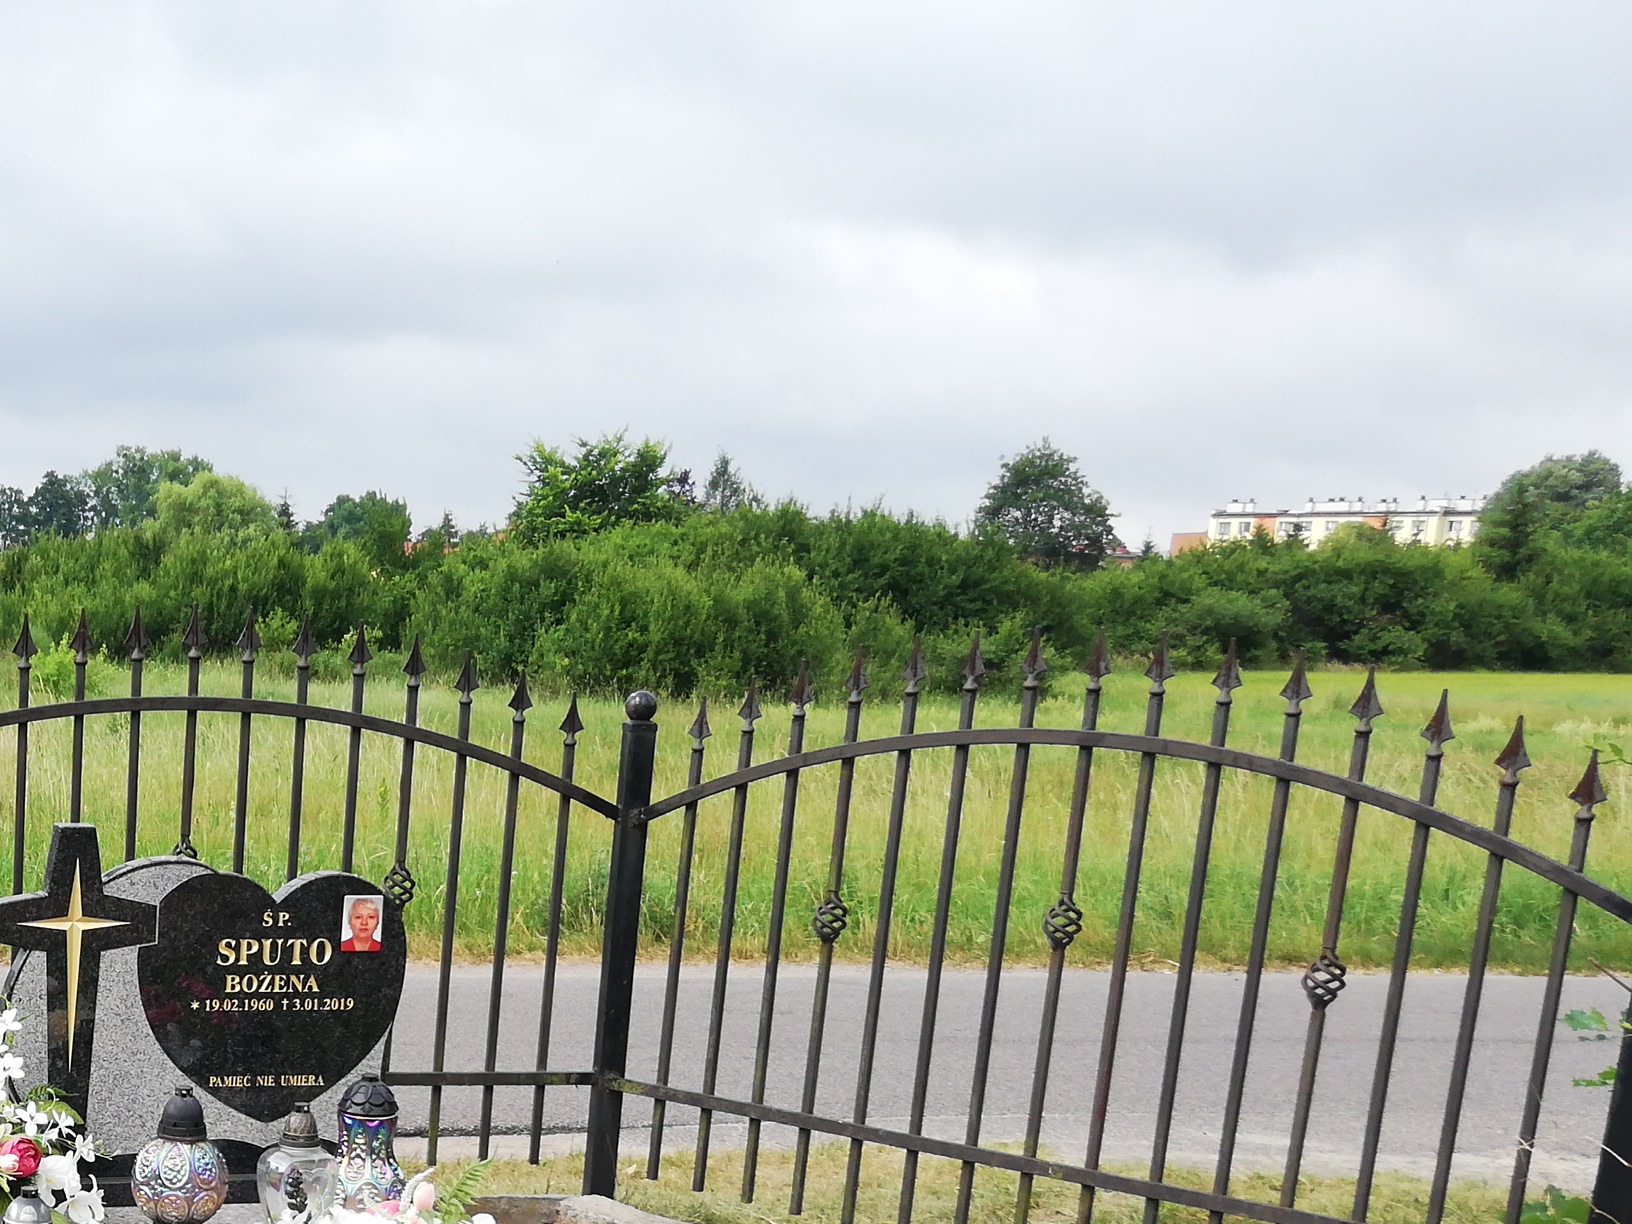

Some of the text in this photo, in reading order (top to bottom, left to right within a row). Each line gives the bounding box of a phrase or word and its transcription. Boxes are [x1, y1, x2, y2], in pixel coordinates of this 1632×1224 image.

[216, 938, 333, 966] SPUTO
[224, 971, 319, 993] BOŻENA
[205, 997, 354, 1012] 19.02.1960 3.01.2019
[256, 1075, 275, 1087] NIE
[280, 1074, 325, 1087] UMIERA
